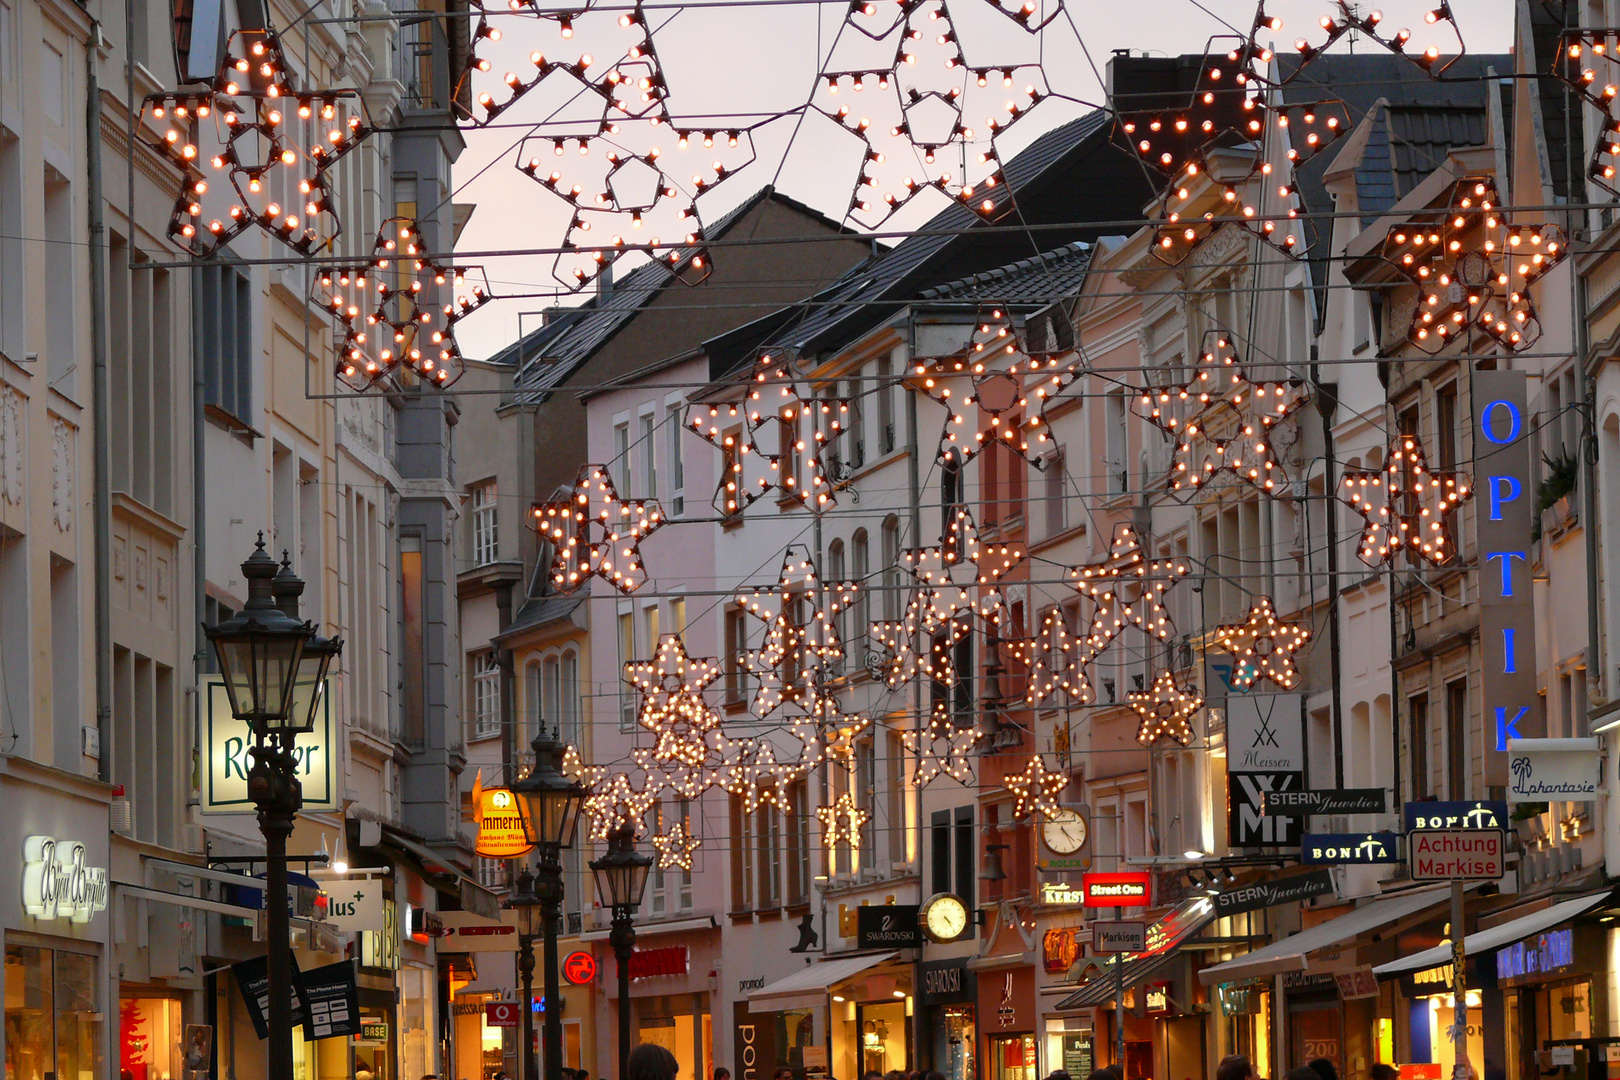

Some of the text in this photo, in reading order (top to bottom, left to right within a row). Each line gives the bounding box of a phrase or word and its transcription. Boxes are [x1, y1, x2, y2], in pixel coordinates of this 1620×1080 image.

[1480, 400, 1530, 752] OPTIK
[224, 736, 320, 781] Rer
[1241, 750, 1291, 768] Meissen
[1269, 792, 1379, 813] STERN Juwelier
[1415, 803, 1499, 829] BONITA
[1312, 835, 1388, 861] BONITA
[1418, 836, 1498, 856] Achtung
[1049, 860, 1081, 868] ROLEX
[1418, 858, 1496, 876] Markise
[1045, 890, 1084, 904] KERST
[1090, 884, 1144, 896] Street One
[1219, 880, 1325, 907] STERN Juwelier
[866, 931, 915, 940] SWAROVSKI
[739, 976, 765, 993] promod
[926, 967, 961, 994] SWAROVSKI
[364, 1026, 385, 1038] BASE
[1304, 1042, 1337, 1058] 200
